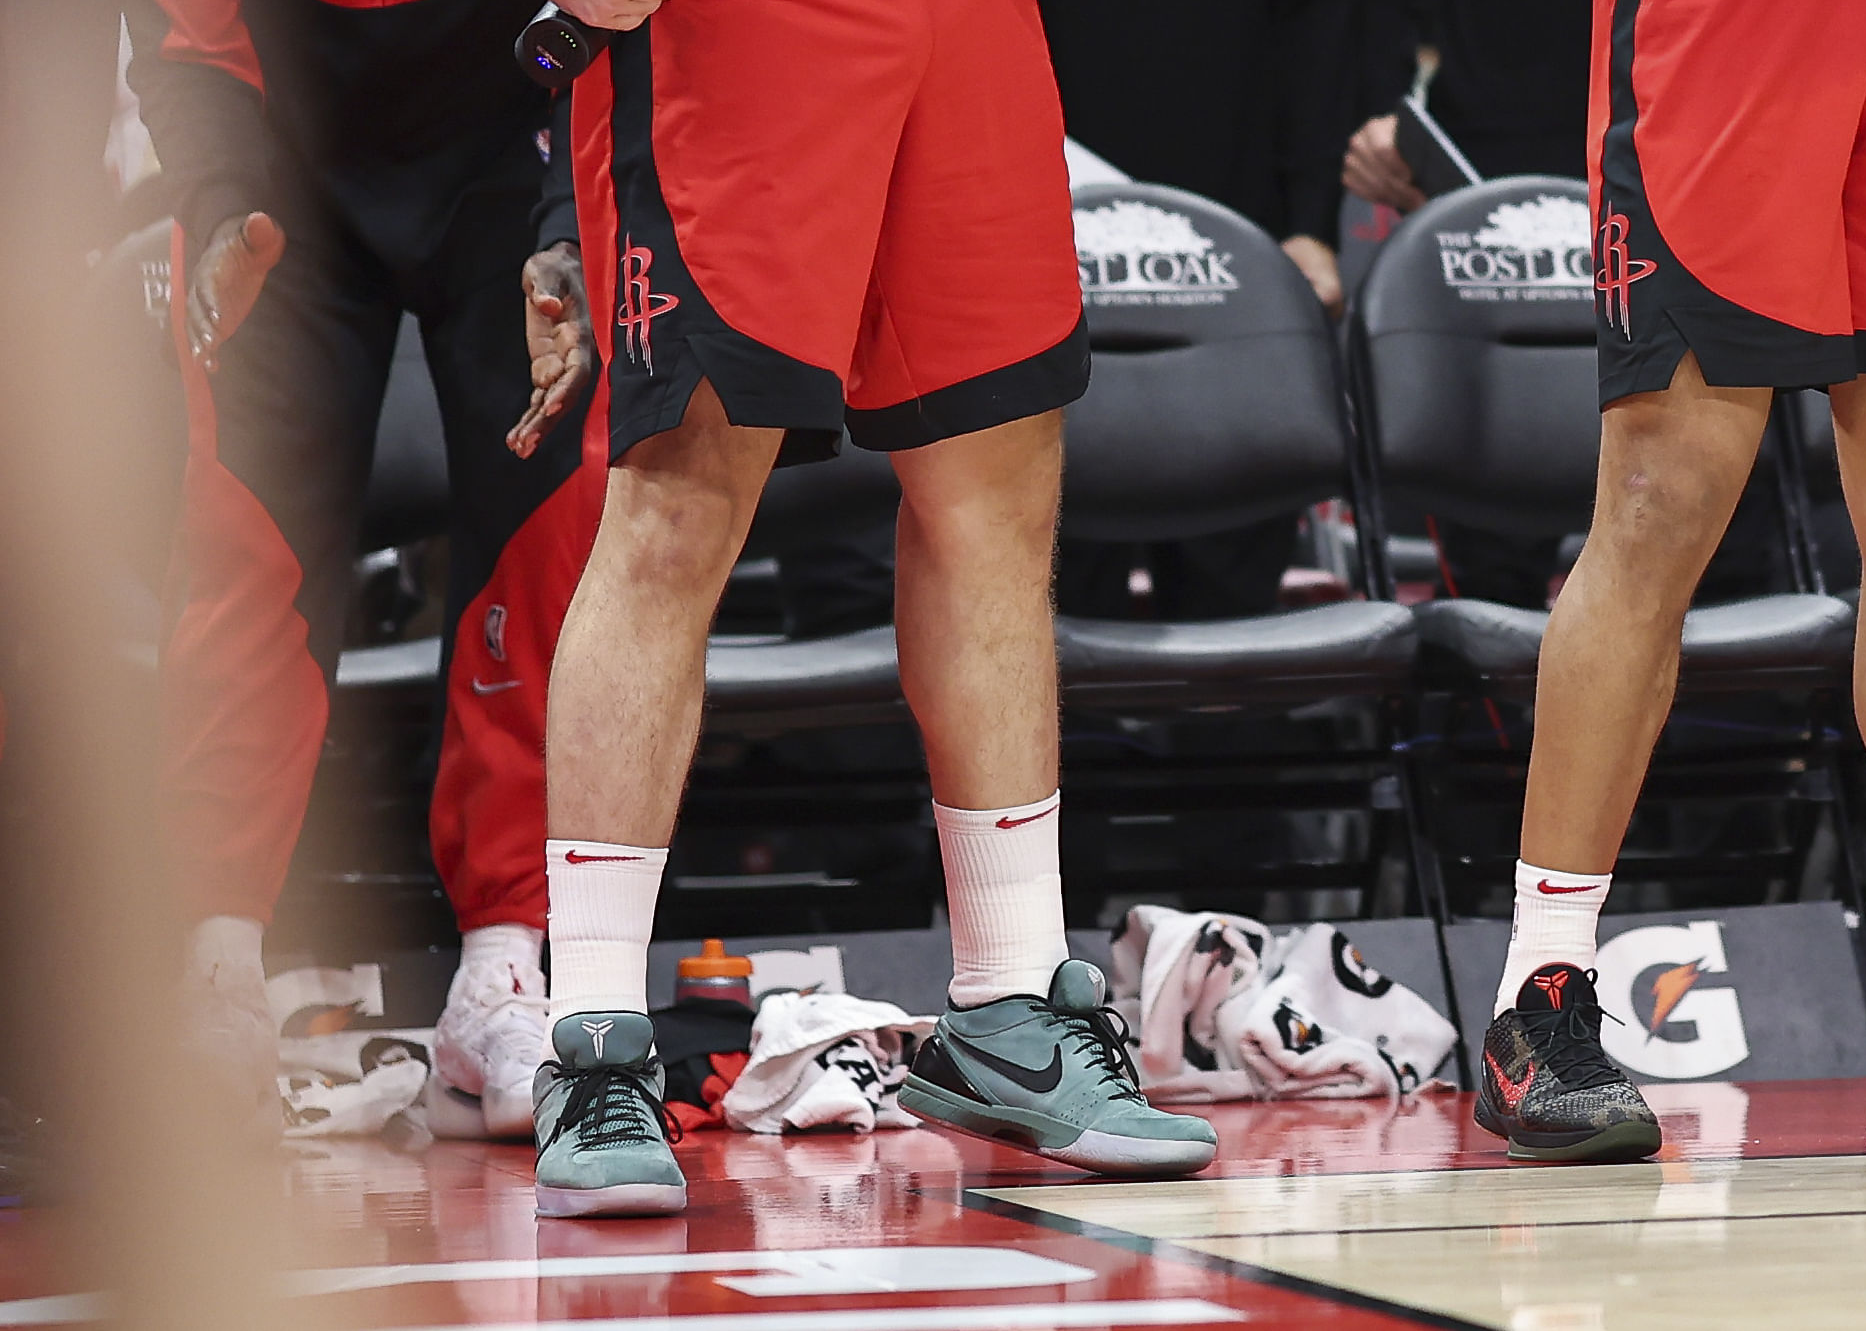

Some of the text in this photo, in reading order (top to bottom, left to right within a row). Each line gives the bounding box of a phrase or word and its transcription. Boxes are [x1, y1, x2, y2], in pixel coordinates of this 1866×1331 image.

[1142, 252, 1240, 289] OAK
[1440, 248, 1546, 283] POST
[1596, 921, 1751, 1080] G
